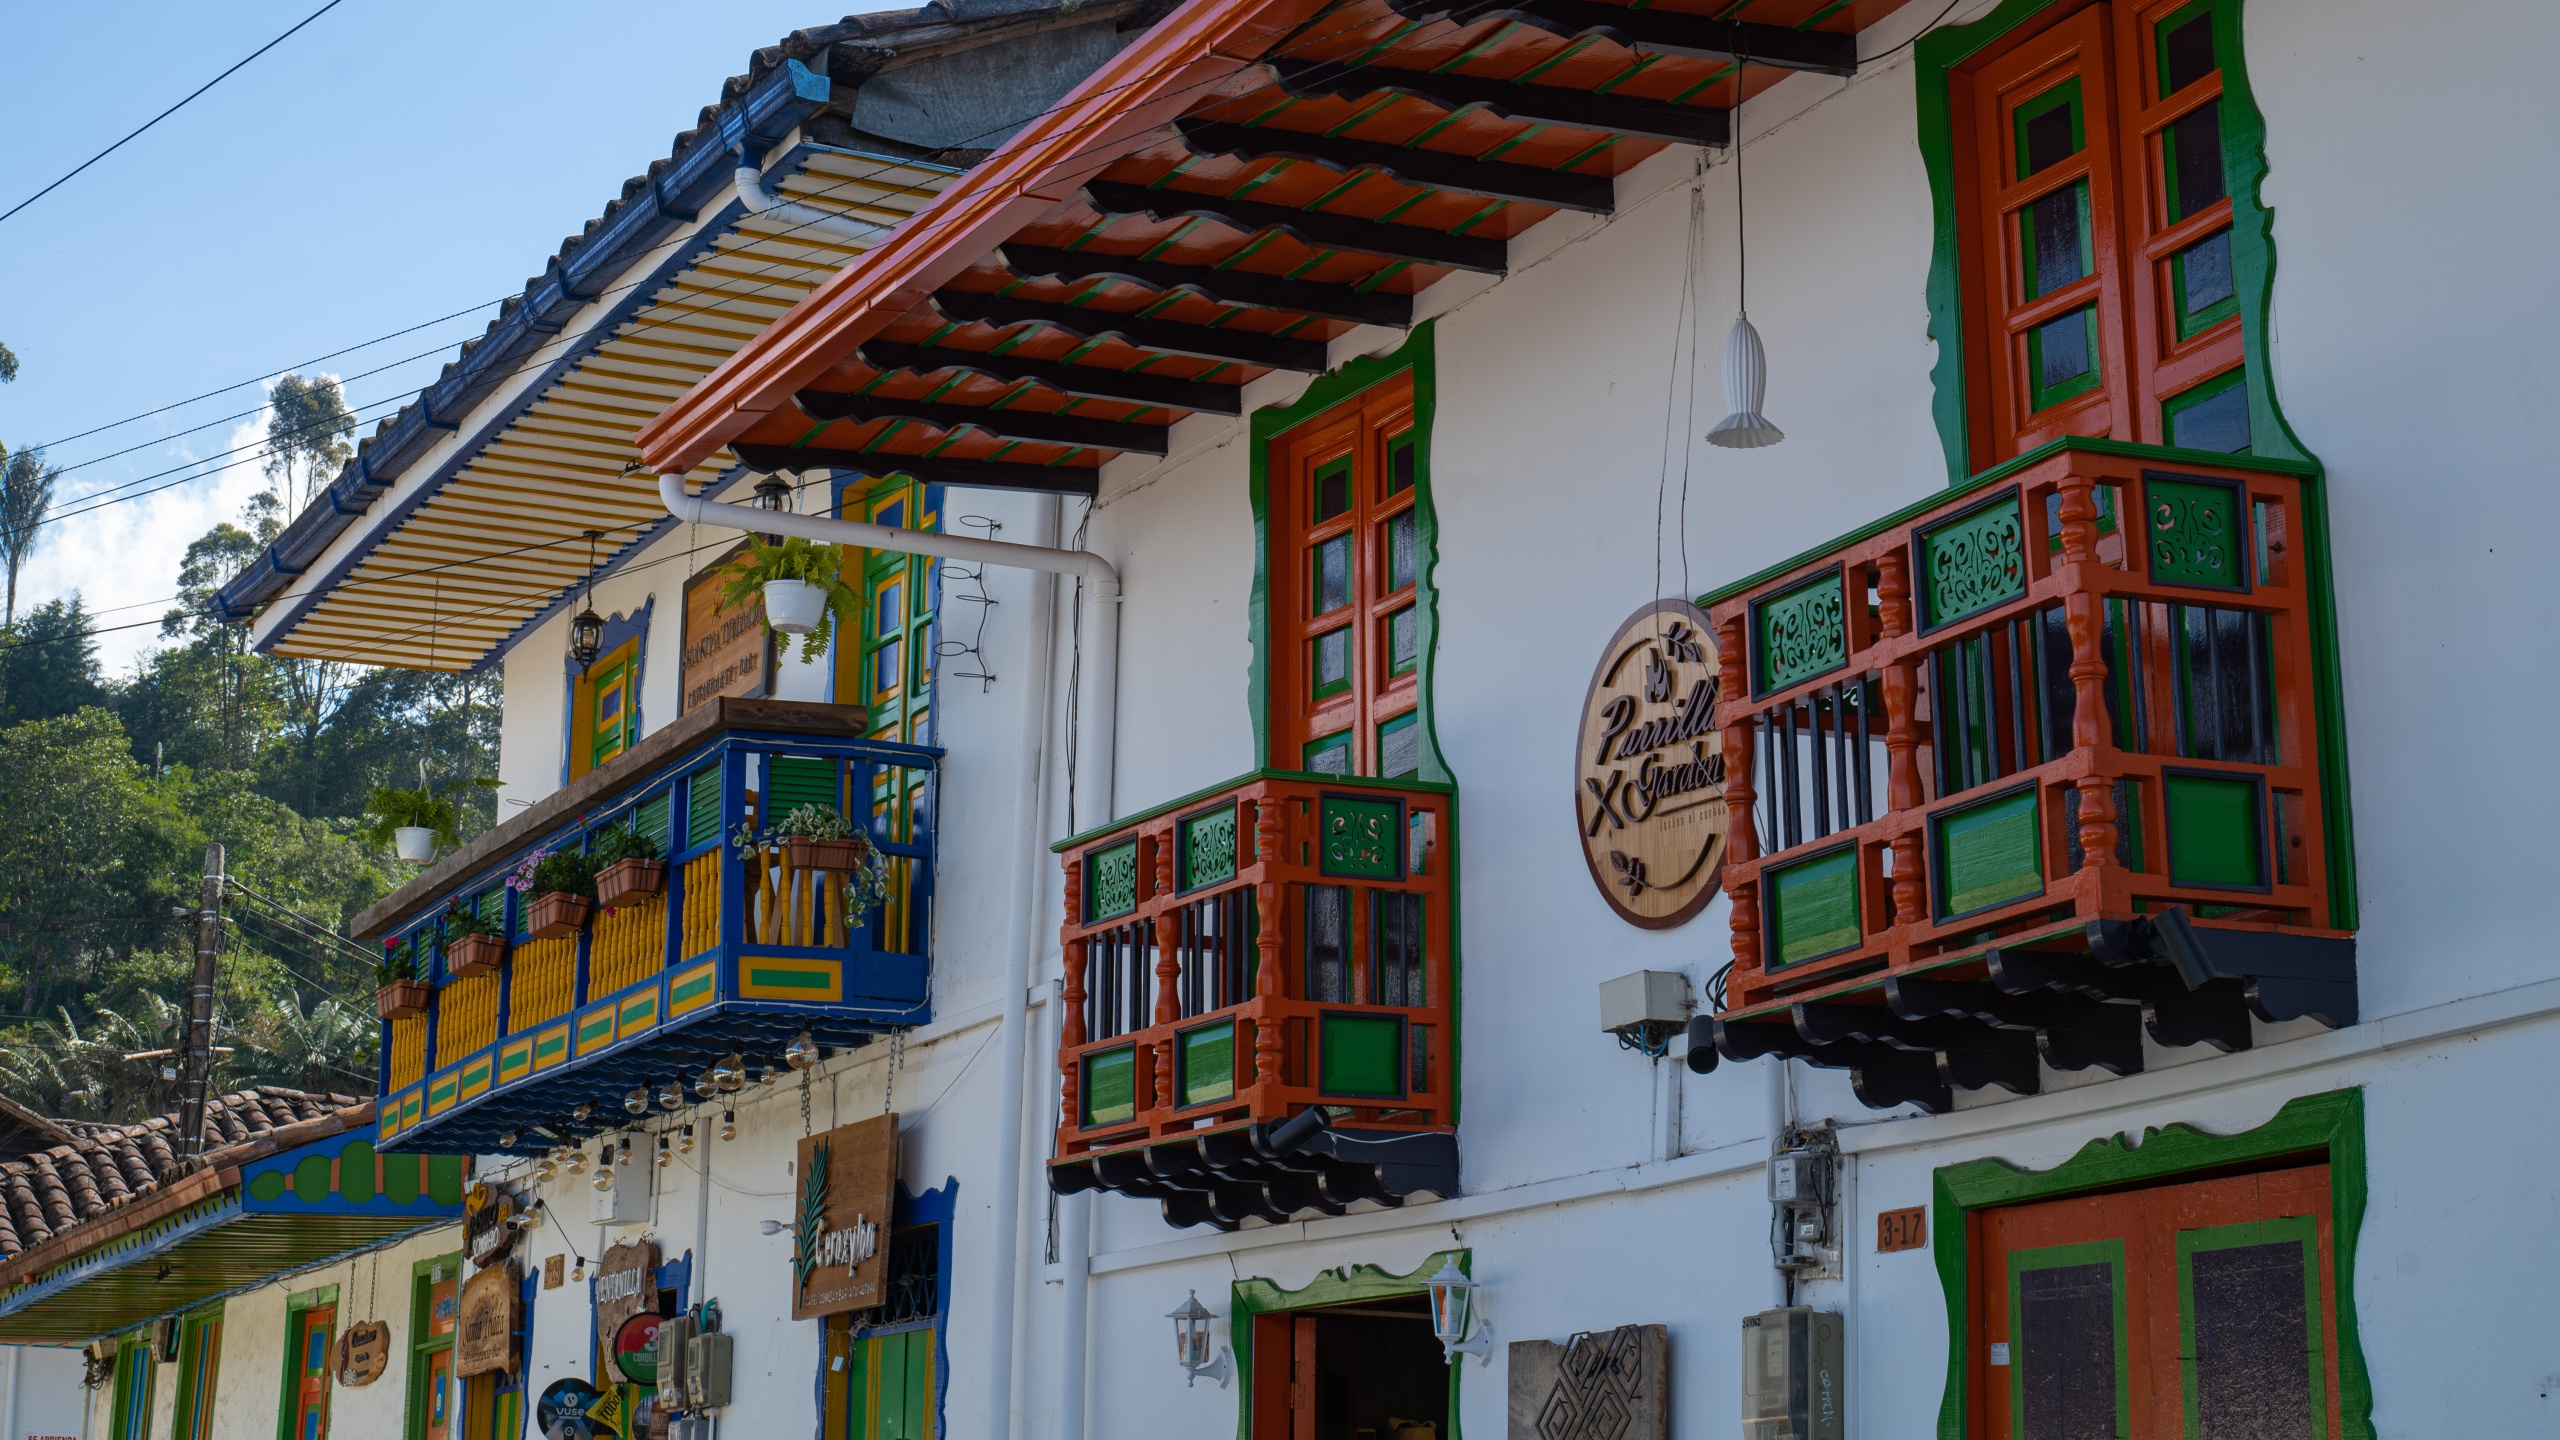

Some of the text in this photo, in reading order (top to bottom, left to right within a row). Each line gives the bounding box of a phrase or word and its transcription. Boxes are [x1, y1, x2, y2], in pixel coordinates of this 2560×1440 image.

[739, 652, 757, 677] BAR
[1595, 675, 1720, 765] Parrilla
[1621, 741, 1726, 822] Garden
[1883, 1213, 1921, 1247] 3-17
[643, 1326, 659, 1352] 3
[599, 1394, 620, 1421] TODO
